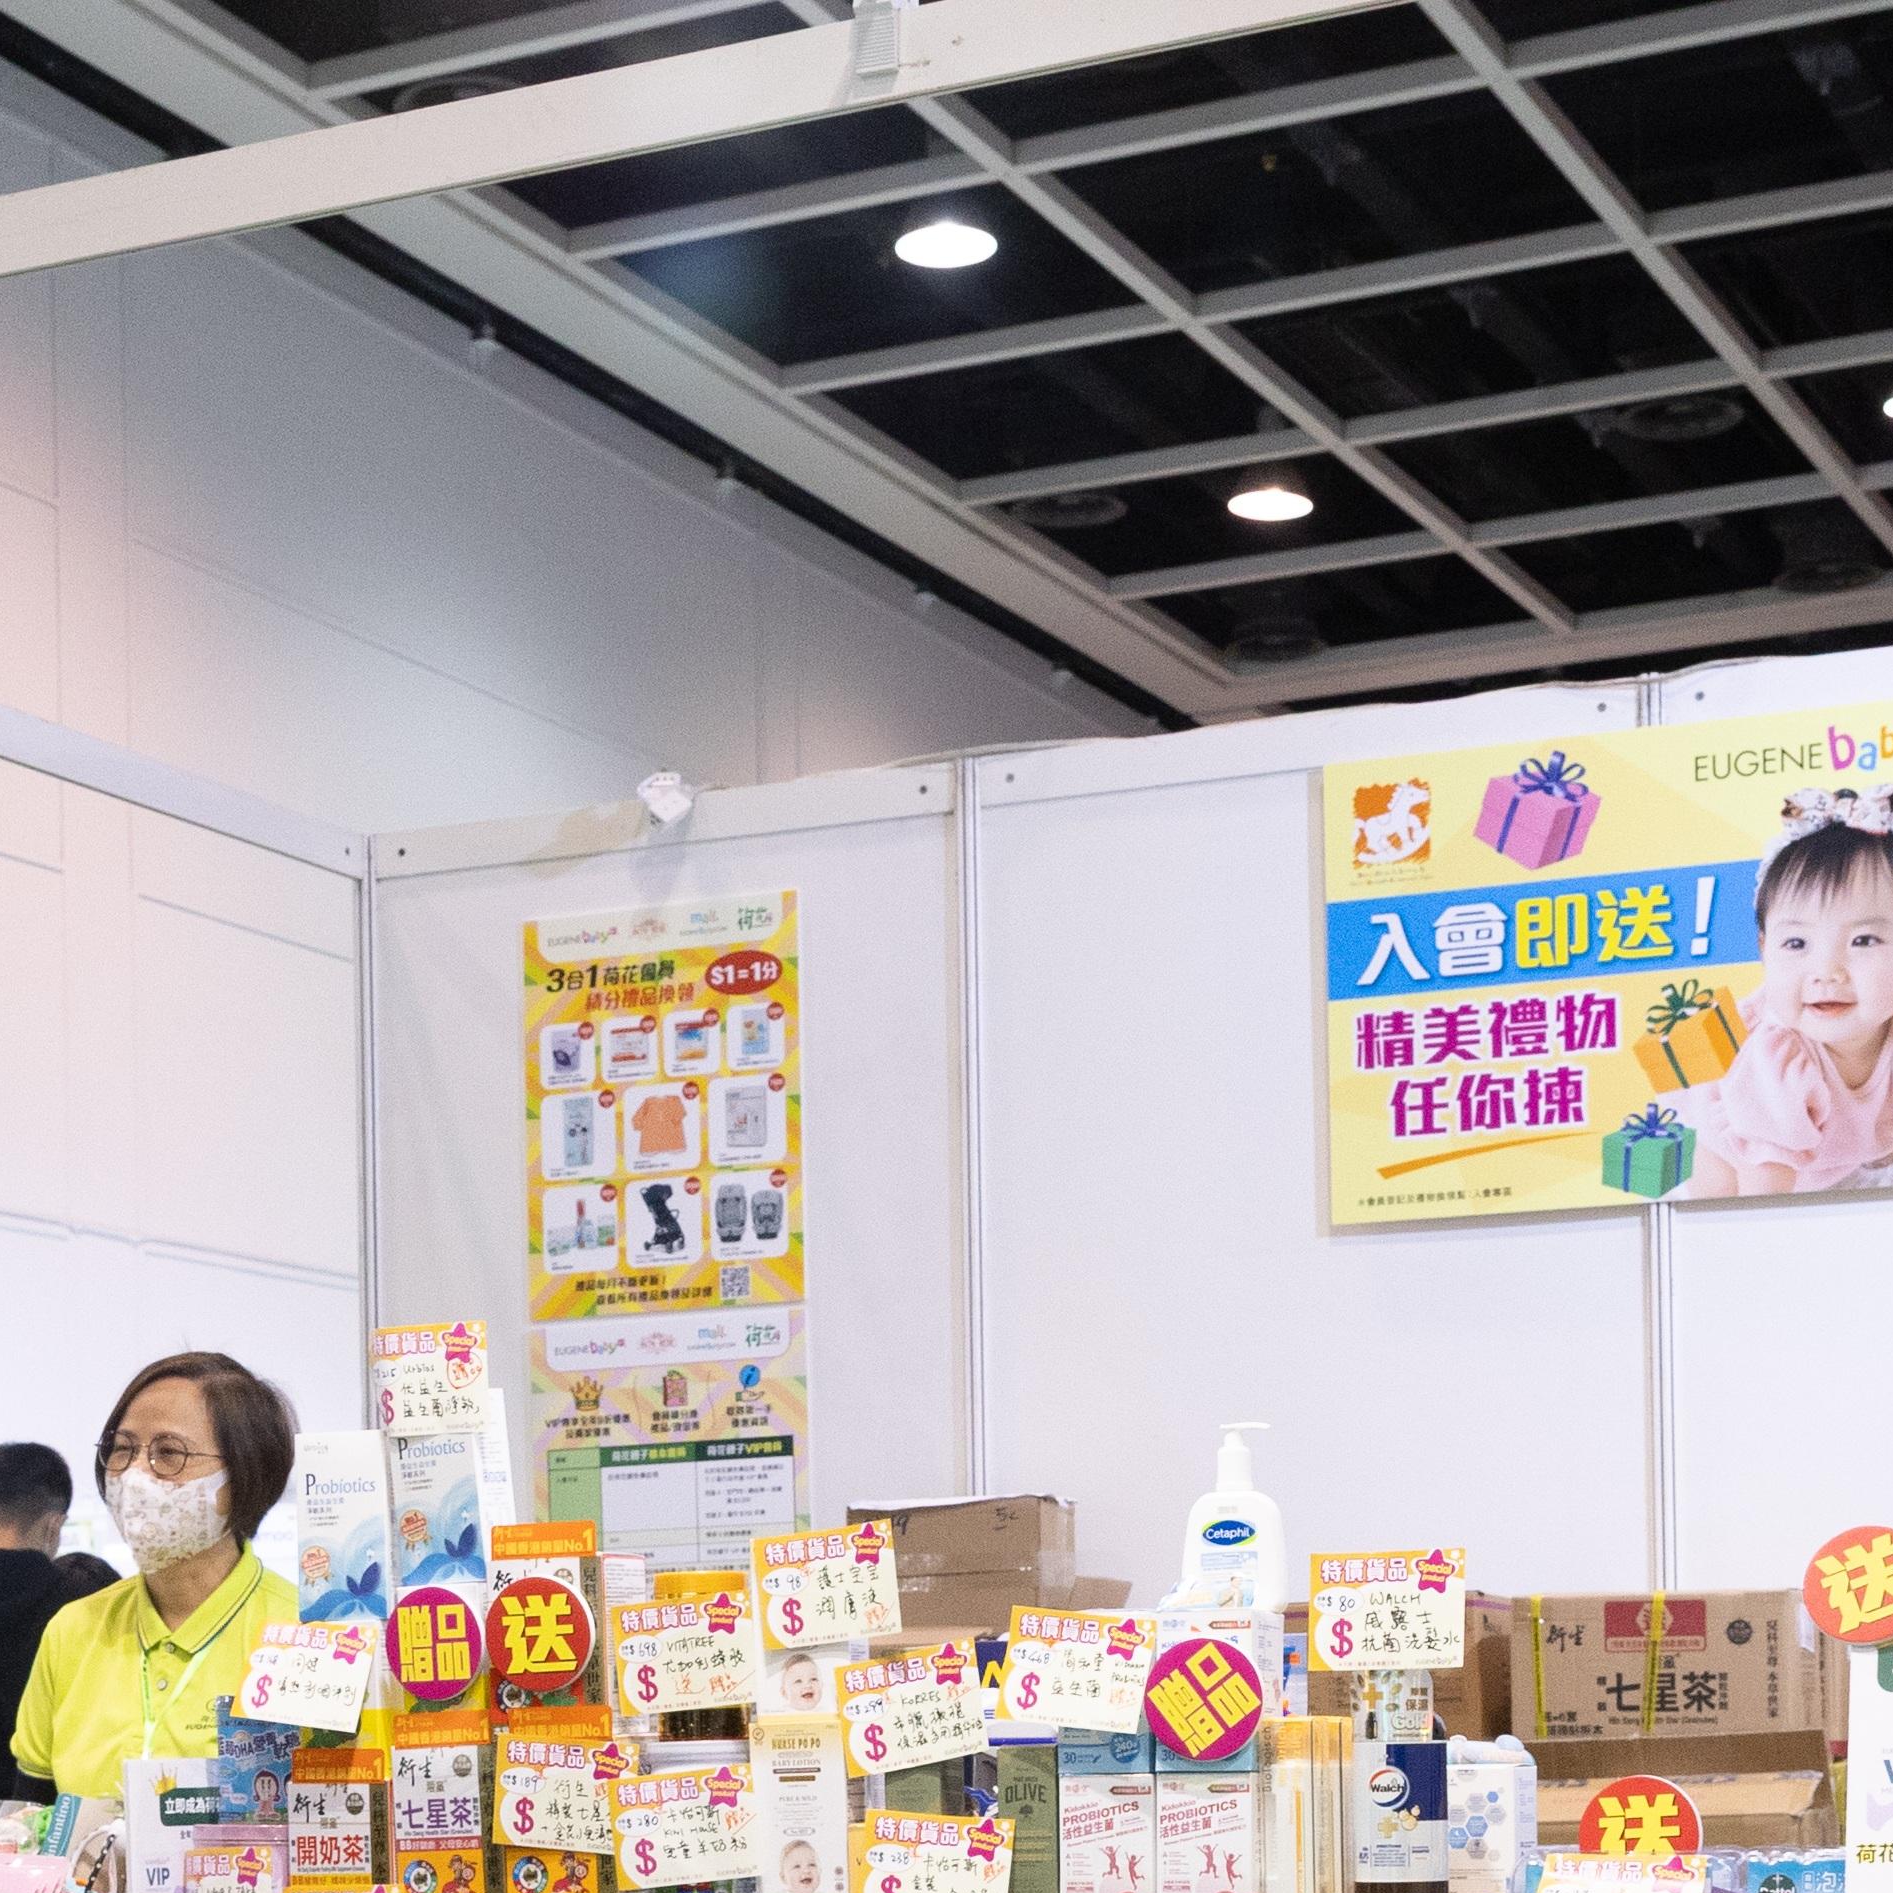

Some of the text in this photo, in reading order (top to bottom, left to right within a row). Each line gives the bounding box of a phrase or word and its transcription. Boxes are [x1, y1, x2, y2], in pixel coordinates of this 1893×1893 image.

[1356, 995, 1618, 1070] 精美禮物
[1391, 1068, 1586, 1138] 任你揀
[398, 1437, 466, 1461] Probiotics
[304, 1473, 376, 1497] Probiotics
[1205, 1525, 1251, 1542] Cetaphil
[764, 1536, 845, 1566] 特價貨品
[1320, 1557, 1408, 1583] 特價貨品
[501, 1592, 578, 1675] 送
[622, 1604, 699, 1634] 特價貨品
[1019, 1614, 1101, 1644] 特價貨品
[397, 1602, 471, 1683] 贈品
[845, 1658, 927, 1692] 特價貨品
[1147, 1642, 1261, 1757] 贈品
[507, 1740, 585, 1770] 特價貨品
[618, 1777, 699, 1805] 特價貨品
[1005, 1784, 1048, 1806] OLIVE
[1370, 1781, 1406, 1794] Walch
[402, 1798, 472, 1829] 七星茶
[1063, 1801, 1140, 1826] PROBIOTICS
[1160, 1799, 1238, 1825] PROBIOTICS
[876, 1816, 959, 1846] 特價貨品
[297, 1834, 363, 1866] 開奶茶
[146, 1867, 170, 1887] VIP
